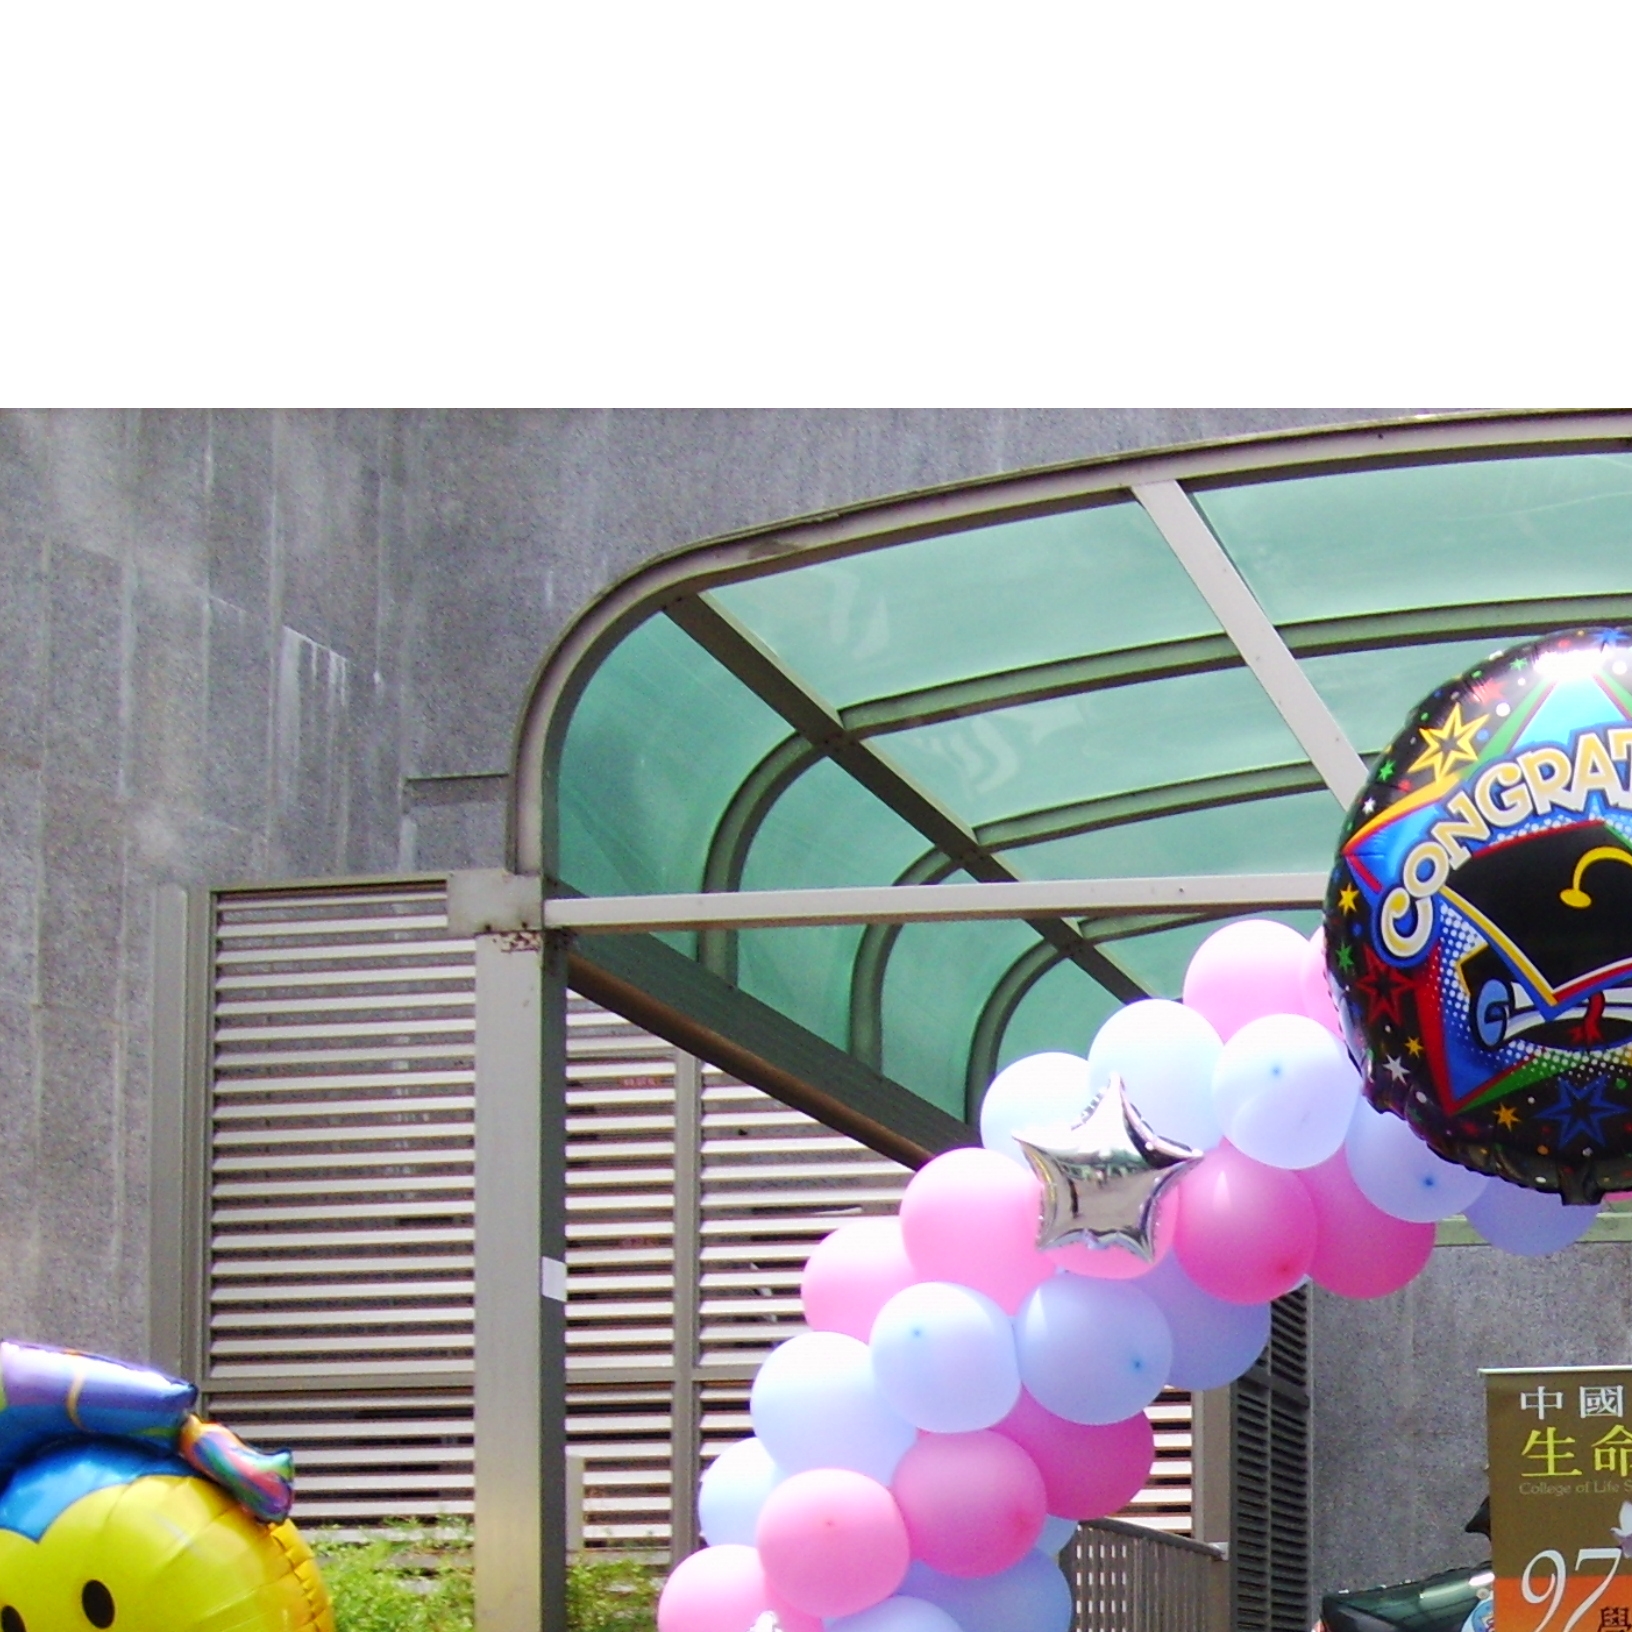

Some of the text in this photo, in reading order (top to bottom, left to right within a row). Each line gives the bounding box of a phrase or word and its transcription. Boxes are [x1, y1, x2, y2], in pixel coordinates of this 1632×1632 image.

[1519, 1481, 1571, 1496] College
[1575, 1480, 1591, 1494] of
[1594, 1480, 1620, 1493] Life
